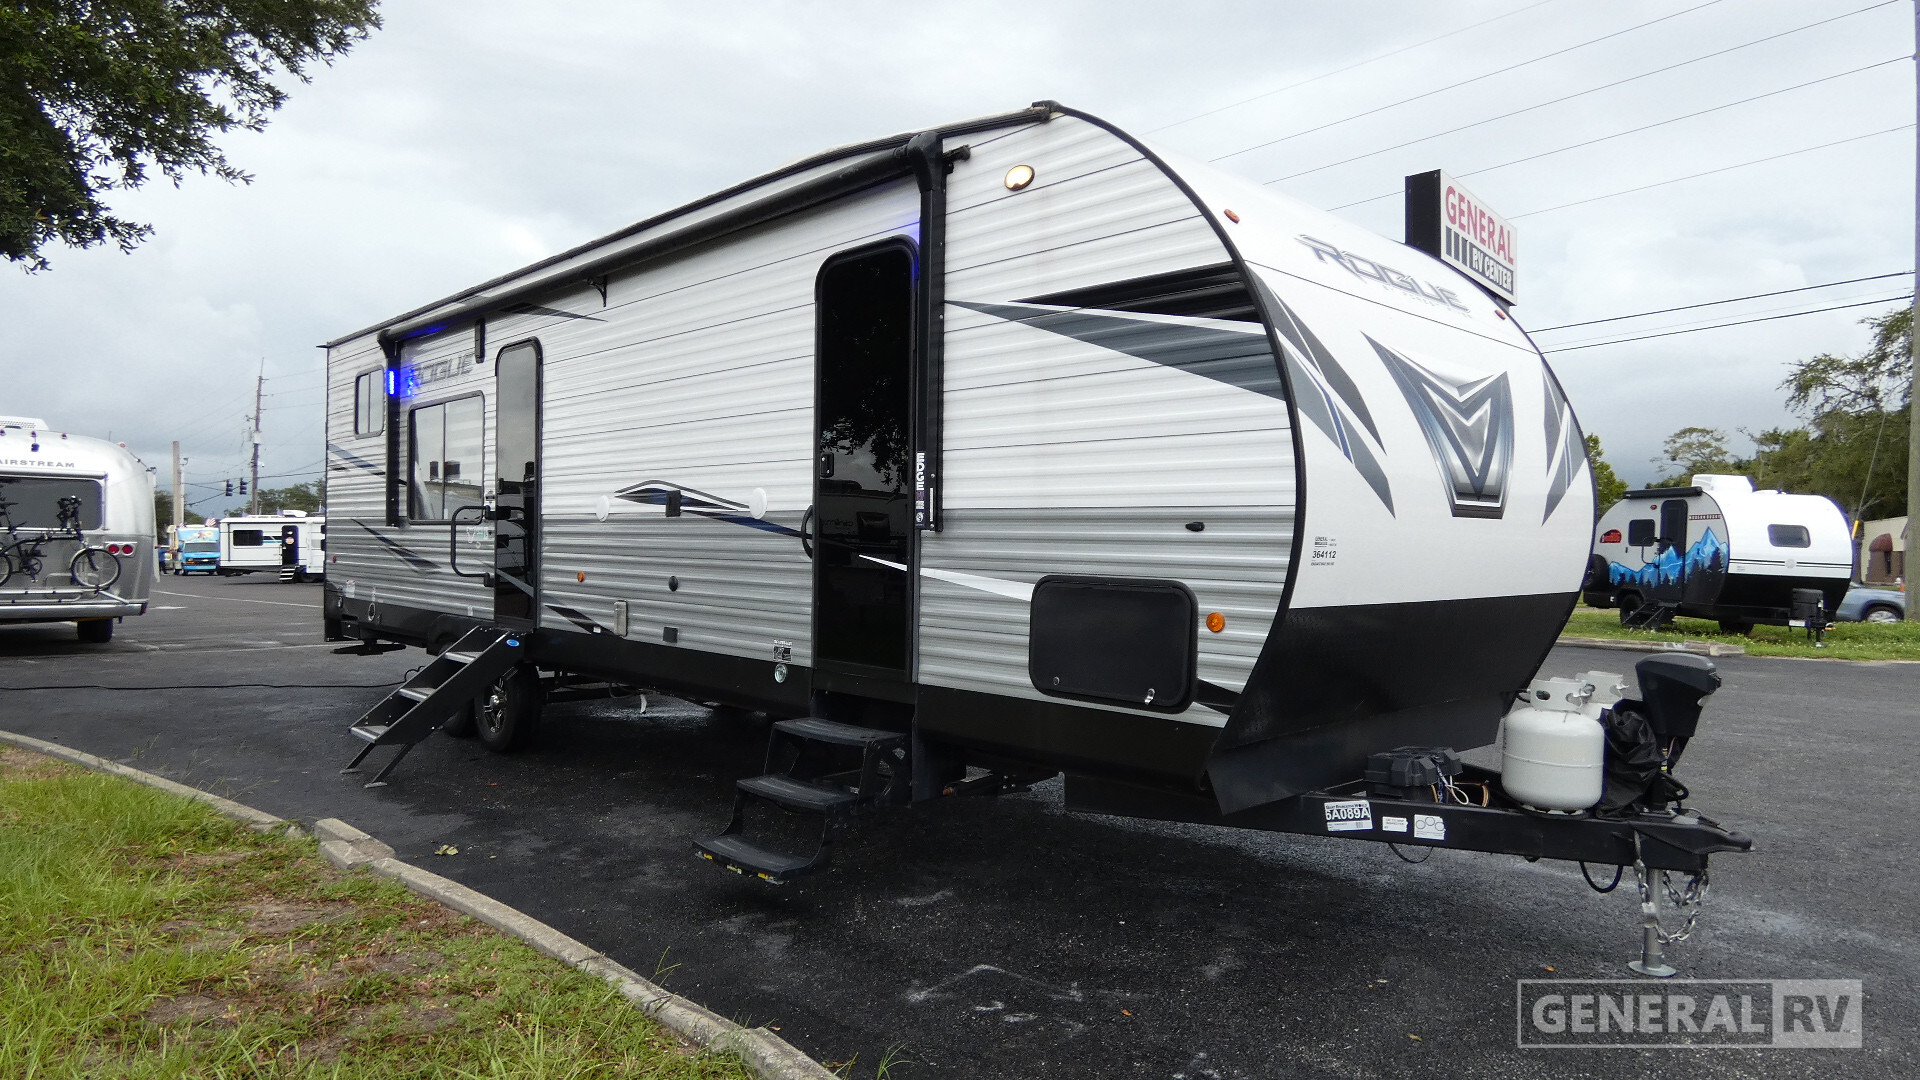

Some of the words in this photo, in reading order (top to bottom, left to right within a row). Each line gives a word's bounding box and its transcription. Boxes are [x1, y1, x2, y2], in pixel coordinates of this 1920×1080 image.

[1445, 185, 1514, 266] GENERAL
[1294, 234, 1471, 313] ROGUE
[1472, 247, 1483, 272] RV
[1484, 256, 1512, 292] CENTER
[916, 452, 926, 491] EDGE
[1312, 550, 1337, 559] 364112
